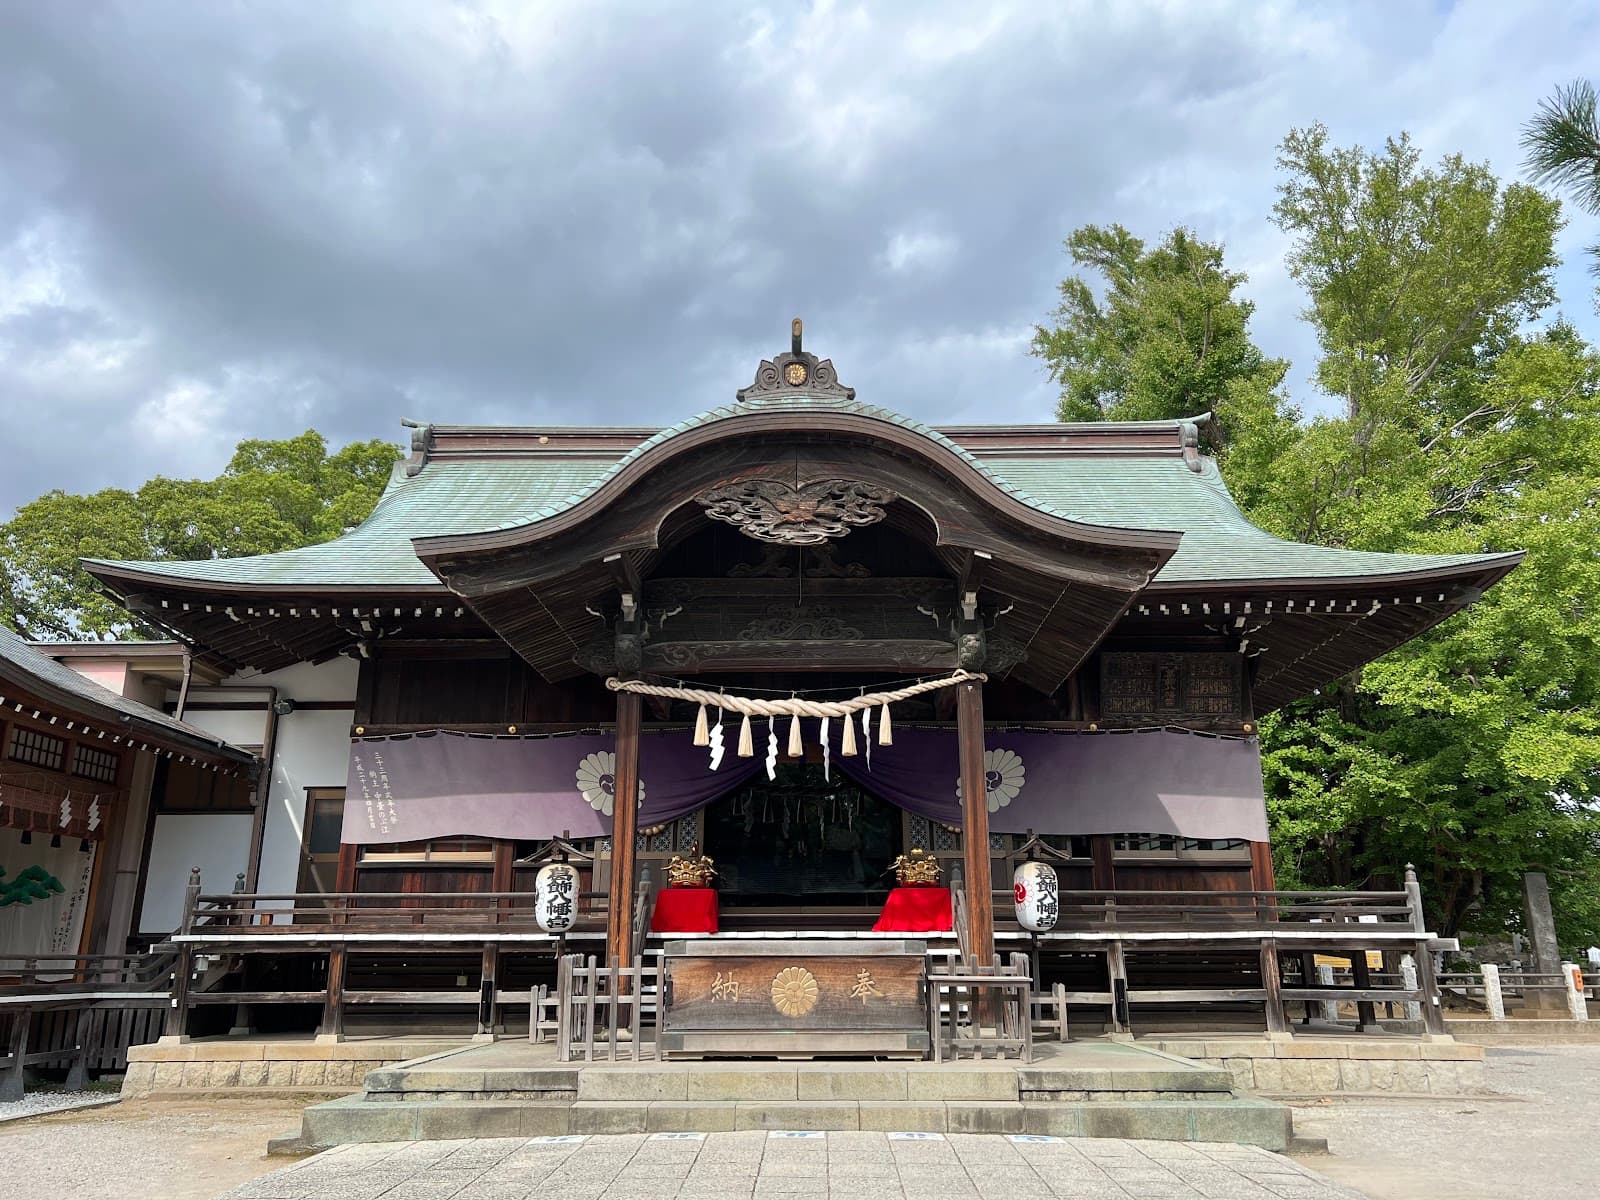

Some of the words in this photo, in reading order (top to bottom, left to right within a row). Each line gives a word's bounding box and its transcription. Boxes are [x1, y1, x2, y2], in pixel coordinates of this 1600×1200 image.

[546, 866, 573, 929] 葛飾八幡宮
[1035, 863, 1058, 928] 葛飾八幡宮
[711, 971, 740, 1003] 納
[850, 968, 884, 1006] 奉
